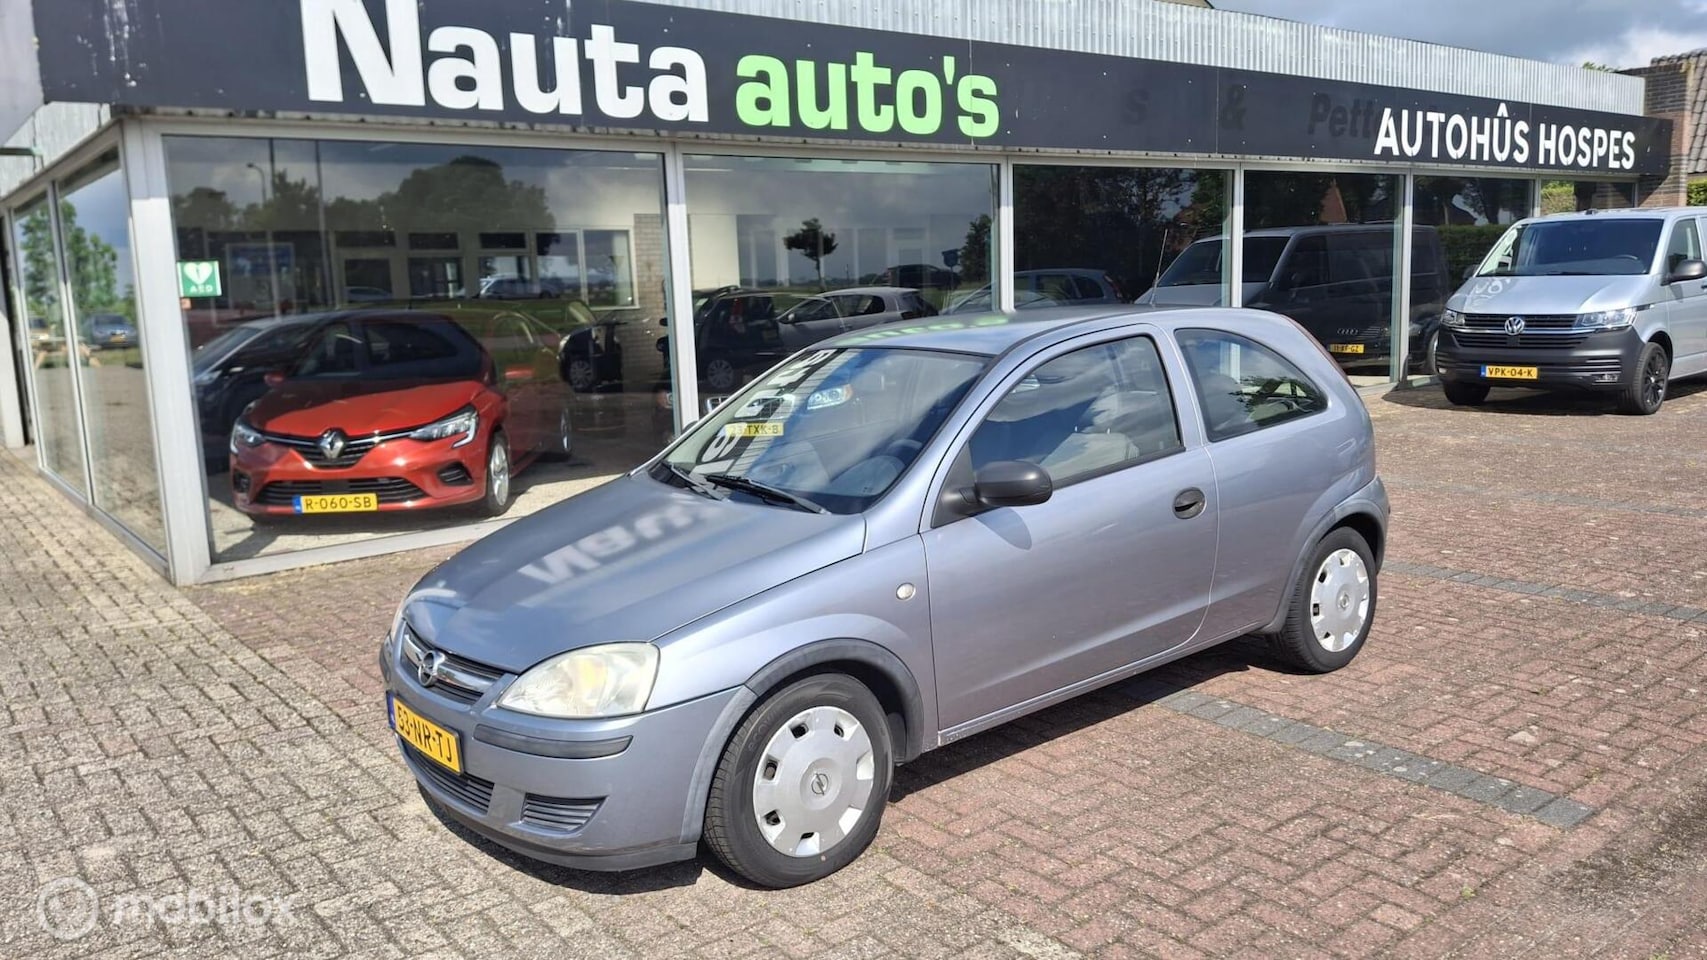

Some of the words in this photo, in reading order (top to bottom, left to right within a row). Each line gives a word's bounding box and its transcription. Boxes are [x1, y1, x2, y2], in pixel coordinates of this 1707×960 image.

[300, 0, 710, 123] Nauta
[735, 51, 1000, 138] auto's
[1374, 102, 1530, 164] AUTOHÛS
[1538, 123, 1636, 170] HOSPES
[189, 284, 214, 294] AED
[1487, 366, 1534, 377] VPK-04-K
[304, 495, 373, 511] R-060-SB
[397, 705, 453, 763] 53-NR-TJ
